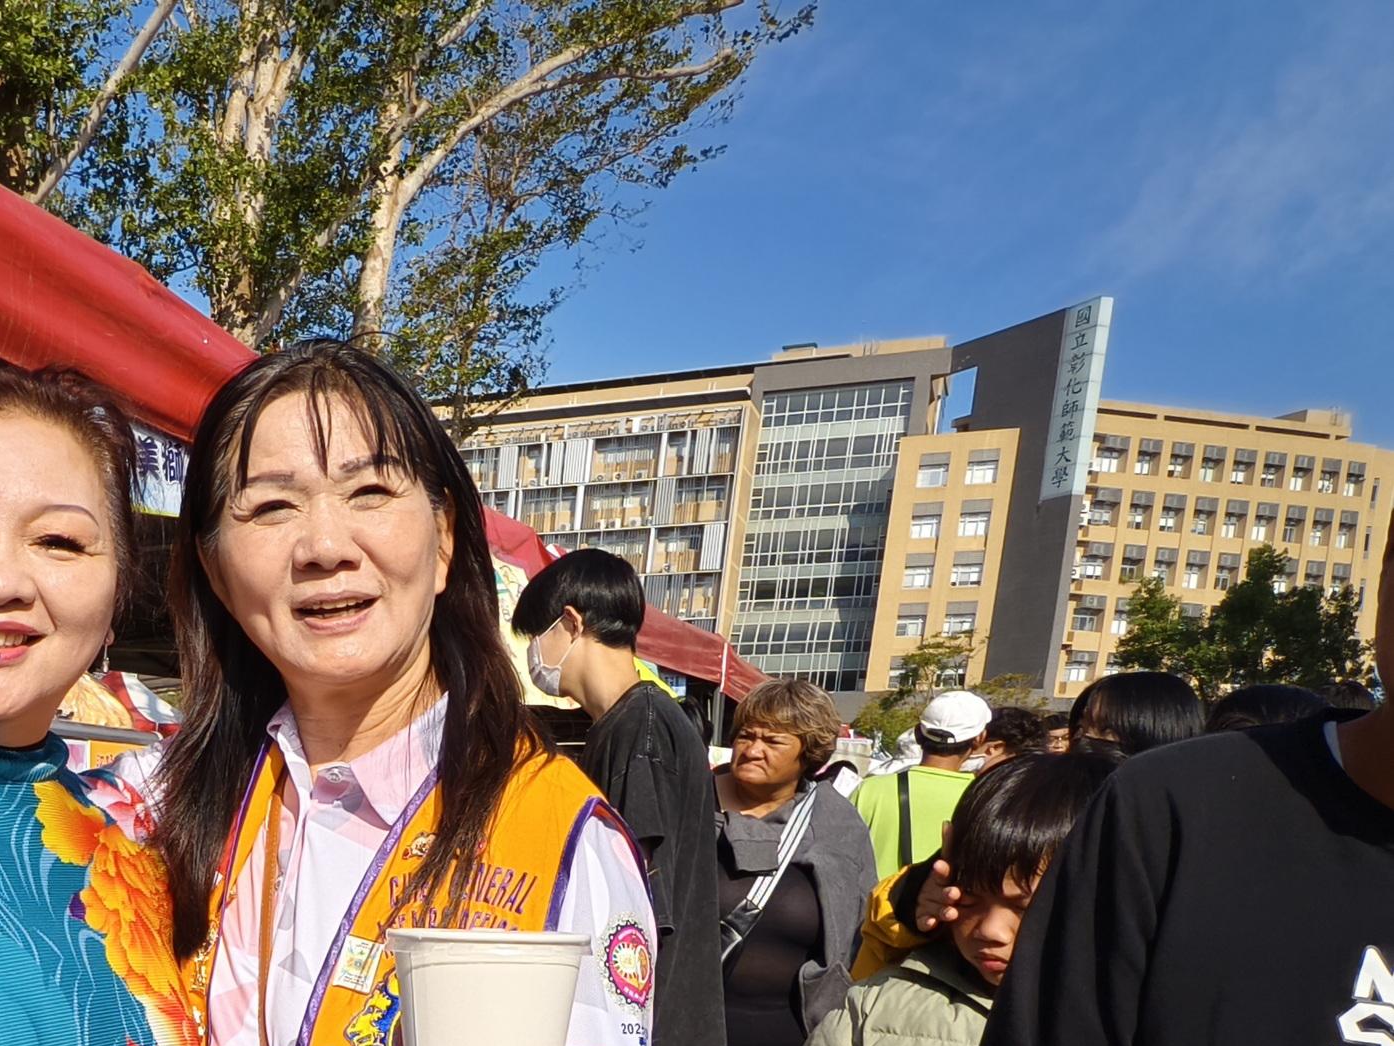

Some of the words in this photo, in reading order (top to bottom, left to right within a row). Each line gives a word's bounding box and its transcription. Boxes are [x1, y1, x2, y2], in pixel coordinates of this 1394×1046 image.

[1051, 304, 1093, 489] 國立彰化師範大學
